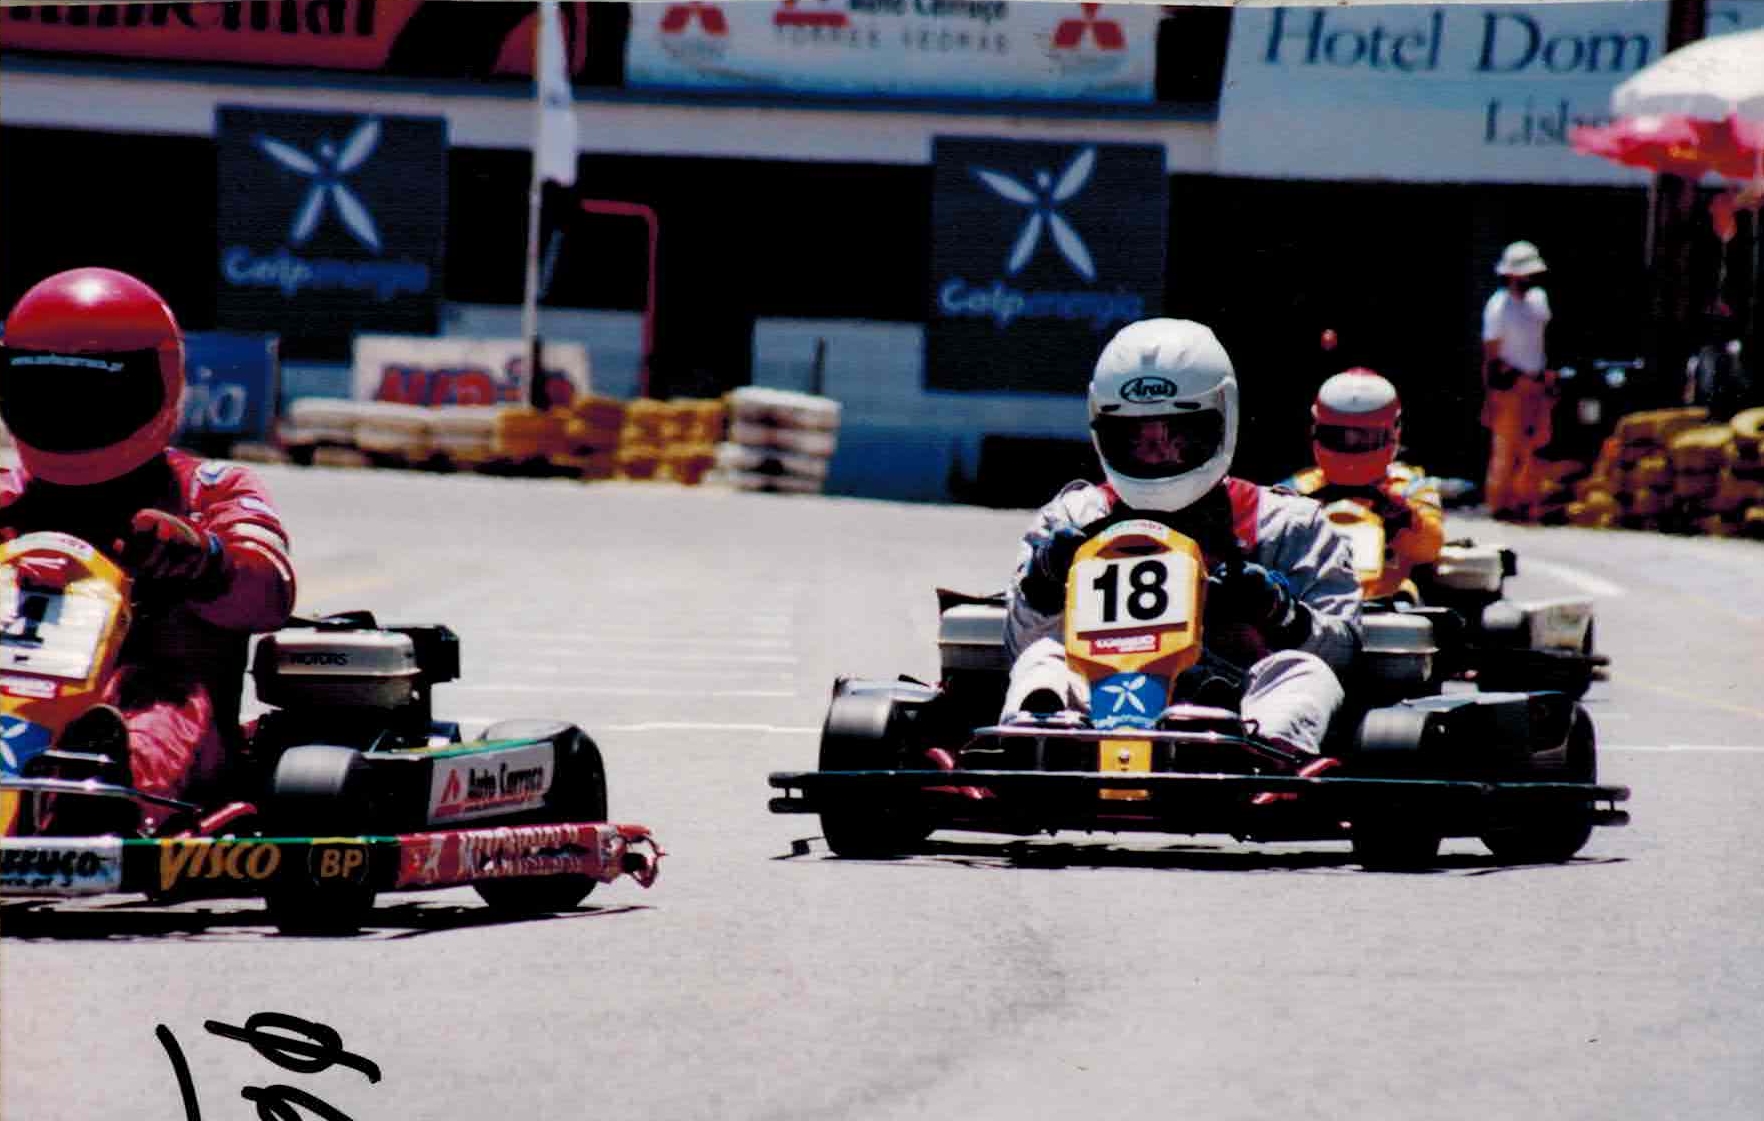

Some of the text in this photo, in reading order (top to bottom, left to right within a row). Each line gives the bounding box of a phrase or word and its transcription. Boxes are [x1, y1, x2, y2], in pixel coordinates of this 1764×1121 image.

[1265, 7, 1652, 72] Hotel Dom
[1093, 559, 1169, 623] 18
[159, 841, 364, 891] VISCO BP
